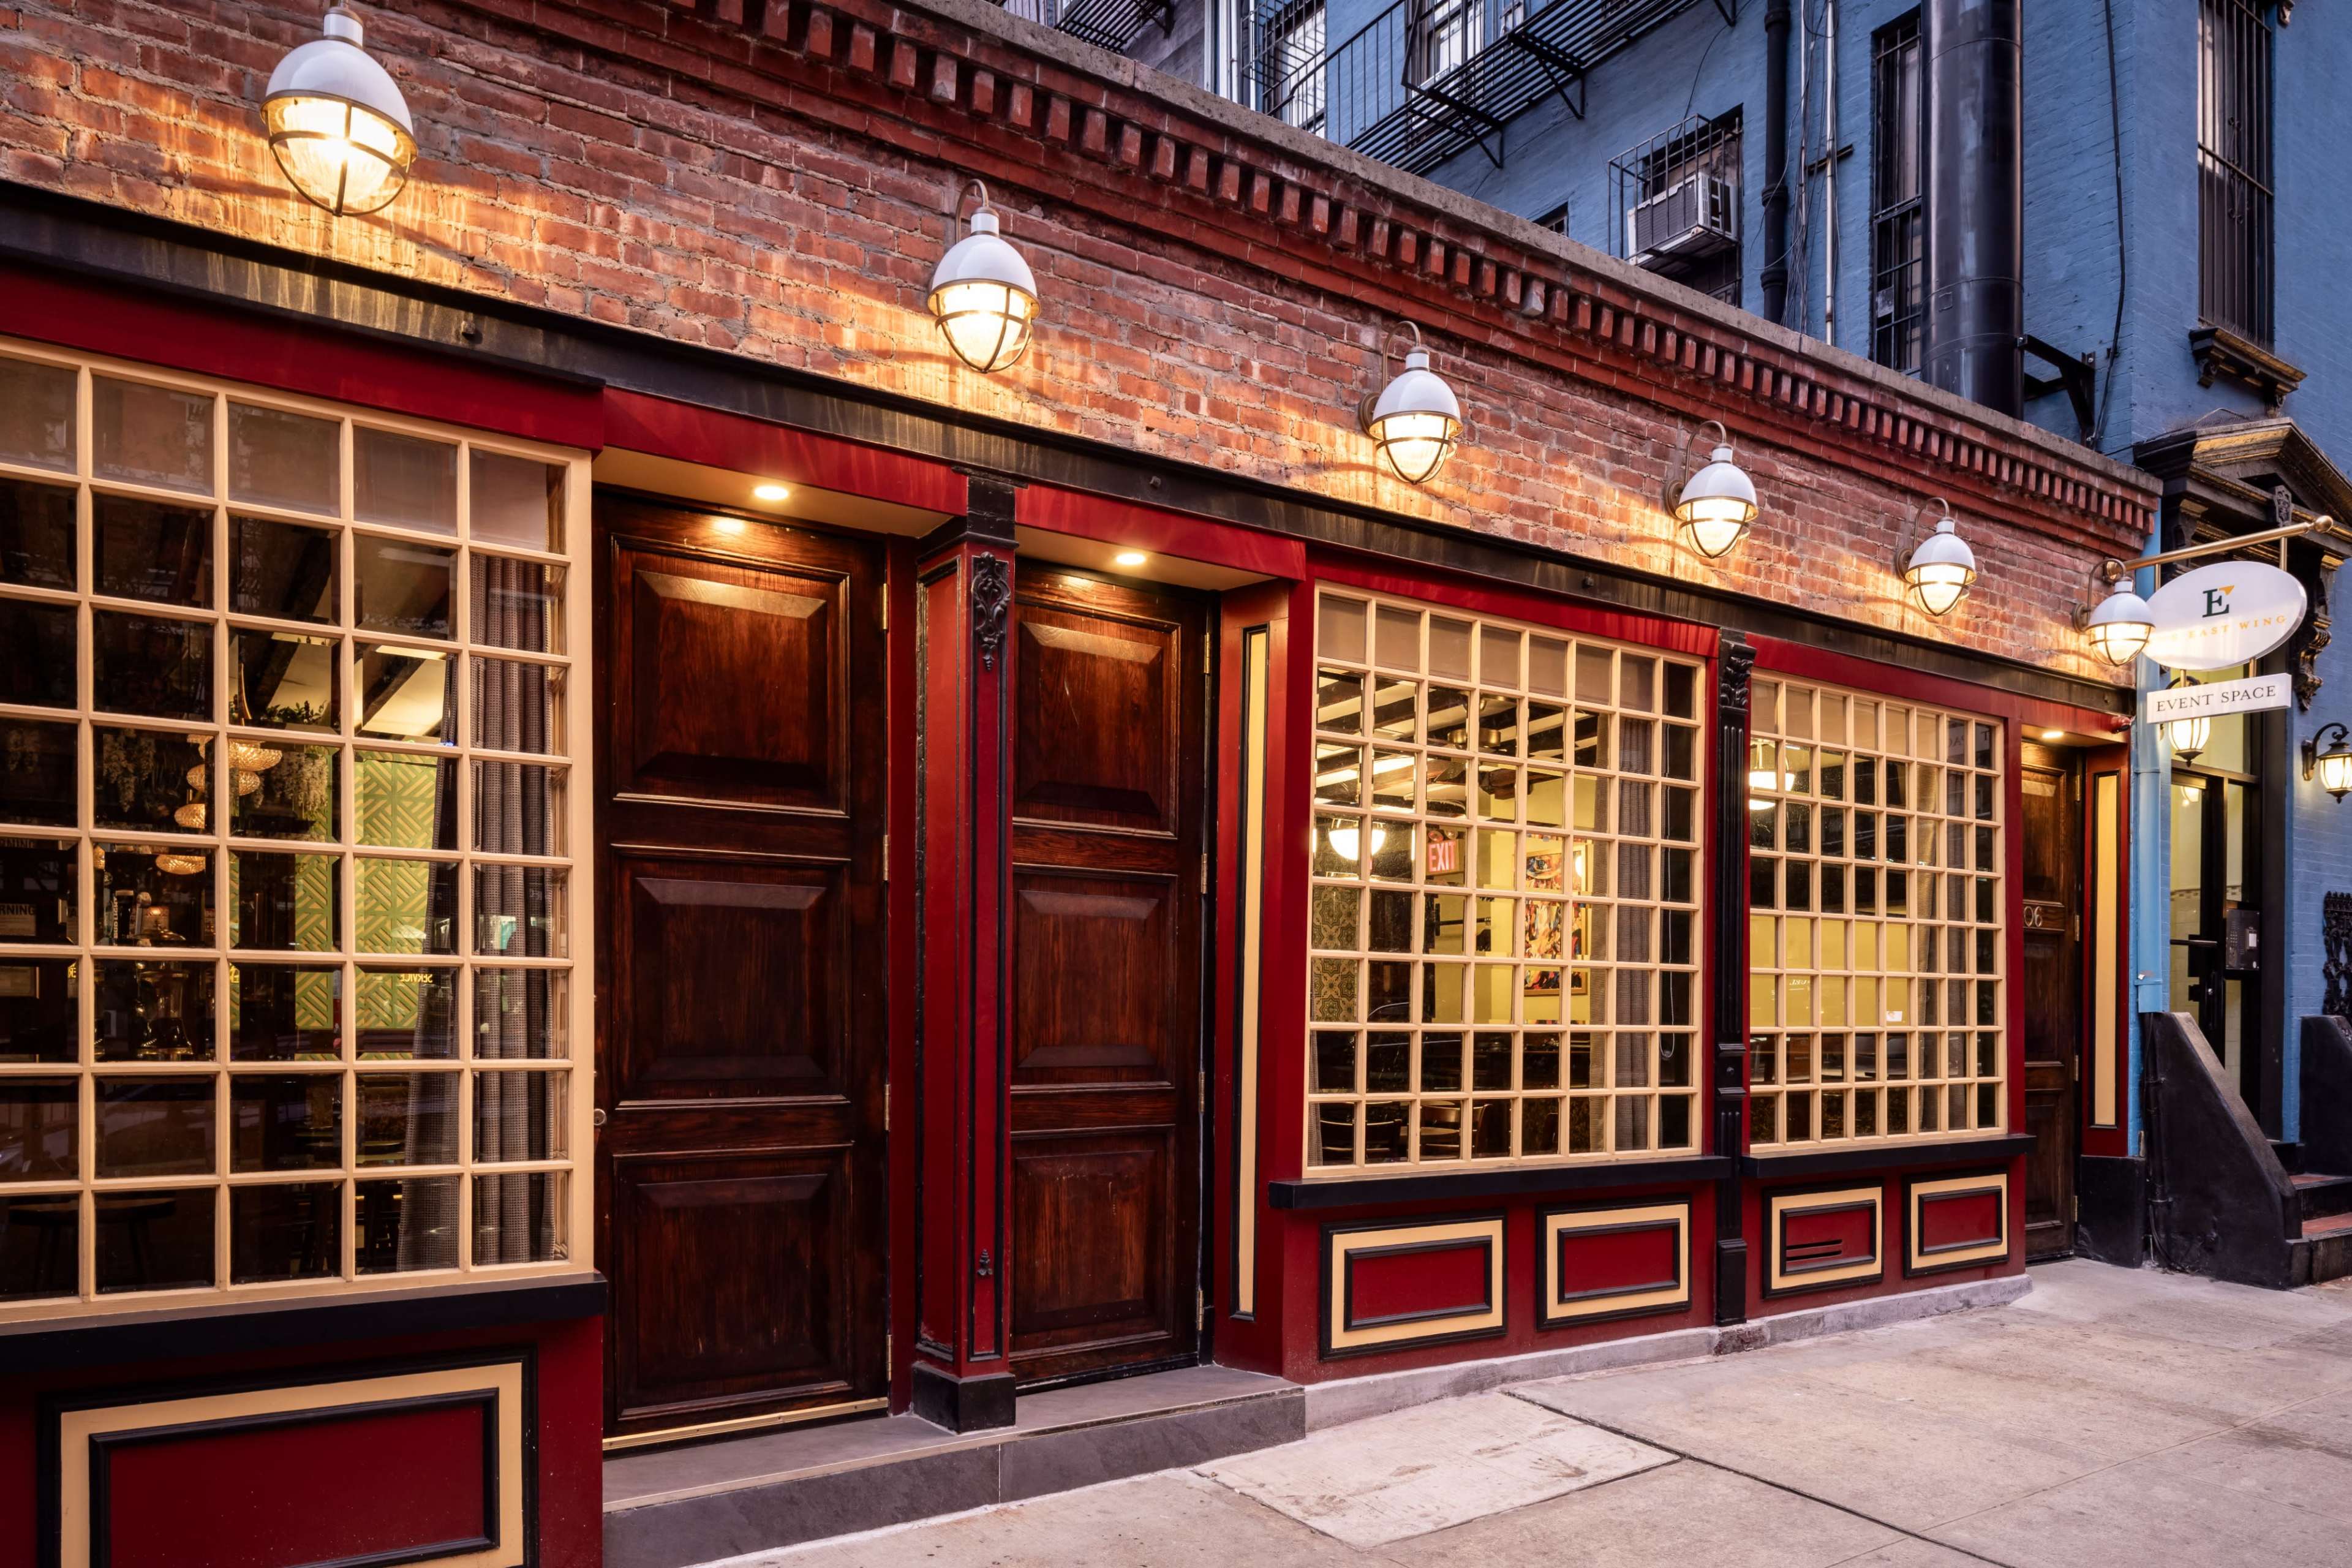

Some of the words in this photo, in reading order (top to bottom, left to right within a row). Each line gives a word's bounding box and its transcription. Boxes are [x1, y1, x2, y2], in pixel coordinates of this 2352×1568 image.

[2203, 589, 2230, 617] E
[2188, 625, 2230, 638] EAST
[2239, 615, 2285, 630] WING
[2157, 694, 2214, 712] EVENT
[2221, 685, 2276, 703] SPACE
[1429, 841, 1455, 872] EXIT
[2024, 906, 2043, 927] 06
